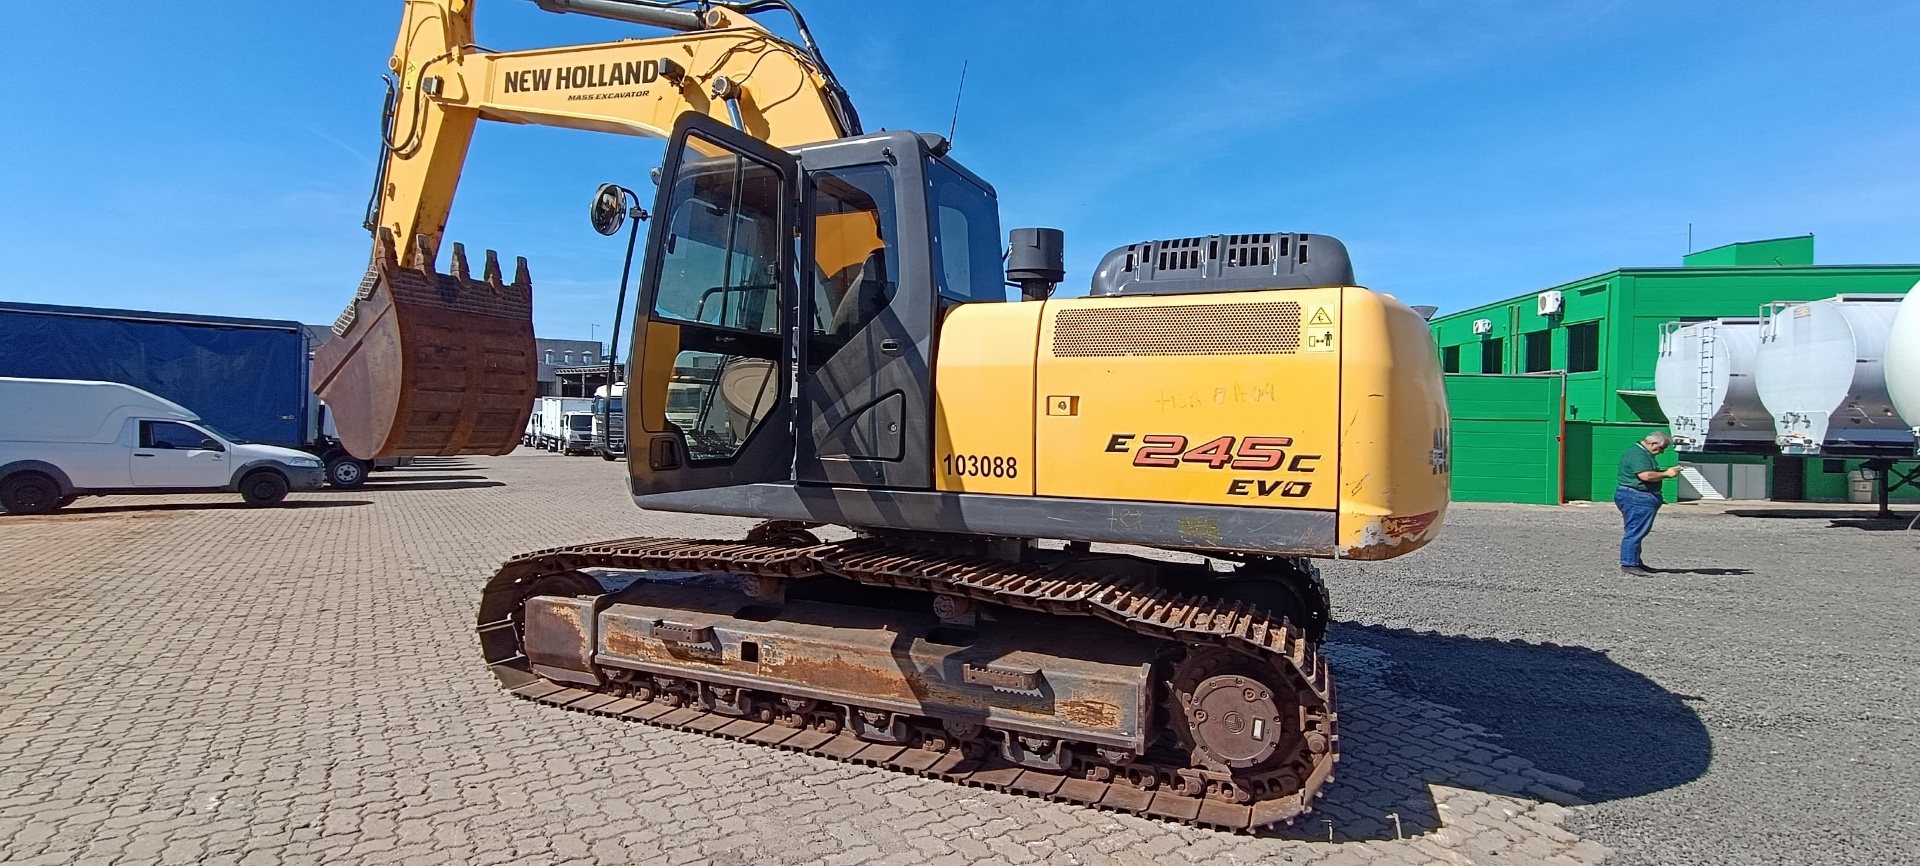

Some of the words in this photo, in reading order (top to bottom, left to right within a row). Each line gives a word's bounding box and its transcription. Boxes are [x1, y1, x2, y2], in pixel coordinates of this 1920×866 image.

[504, 69, 551, 93] NEW
[555, 59, 659, 90] HOLLAND
[595, 90, 650, 100] EXCAVATOR
[943, 453, 1018, 479] 103088
[1226, 479, 1312, 498] EVO
